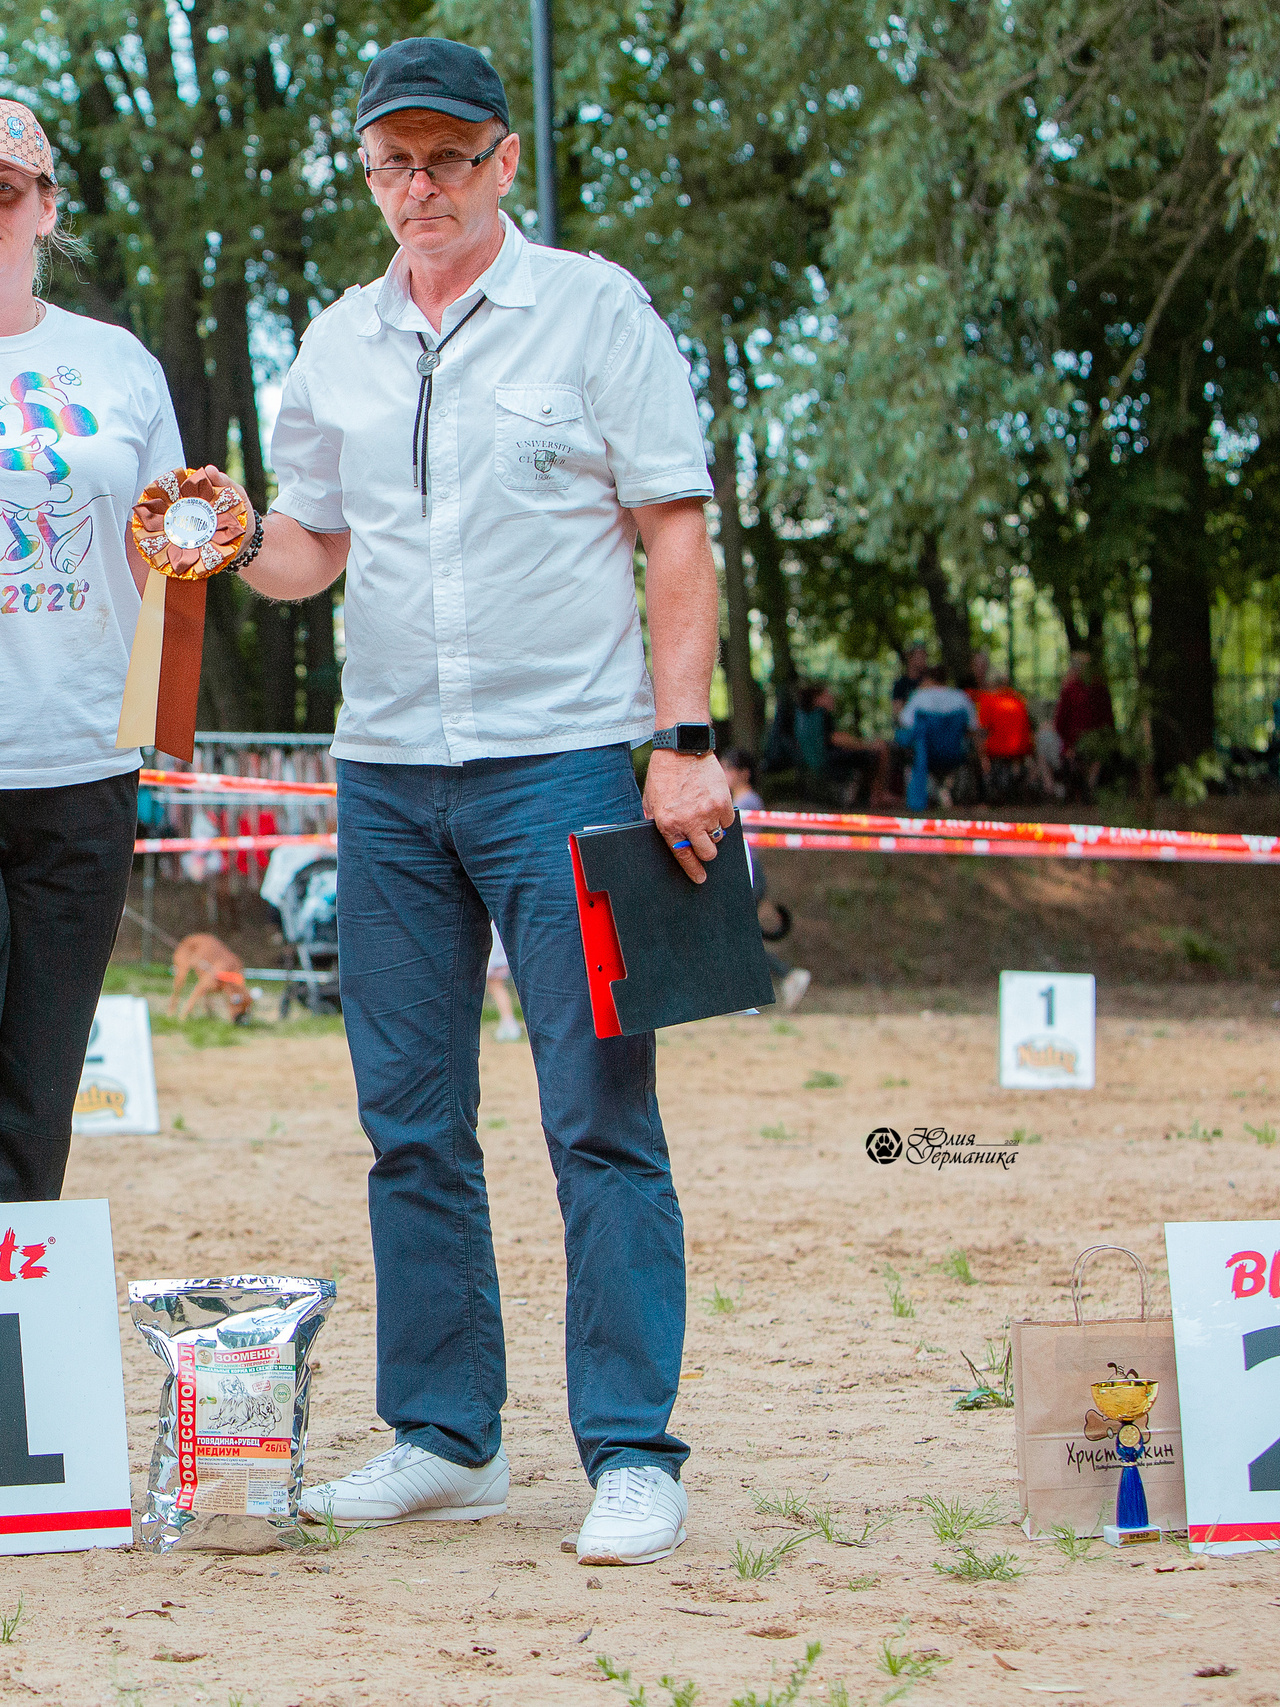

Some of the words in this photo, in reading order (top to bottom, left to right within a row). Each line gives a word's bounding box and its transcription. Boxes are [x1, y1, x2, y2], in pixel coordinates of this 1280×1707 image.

[516, 440, 574, 454] UNIVERSITY
[0, 578, 90, 614] 2020
[1039, 985, 1055, 1026] 1
[216, 1348, 278, 1362] ЗООМЕНЮ
[179, 1345, 195, 1508] ПРОФЕССИОНАЛ
[197, 1446, 240, 1457] МЕДИУМ
[265, 1443, 287, 1453] 26/15
[1066, 1442, 1174, 1473] Хрусткин
